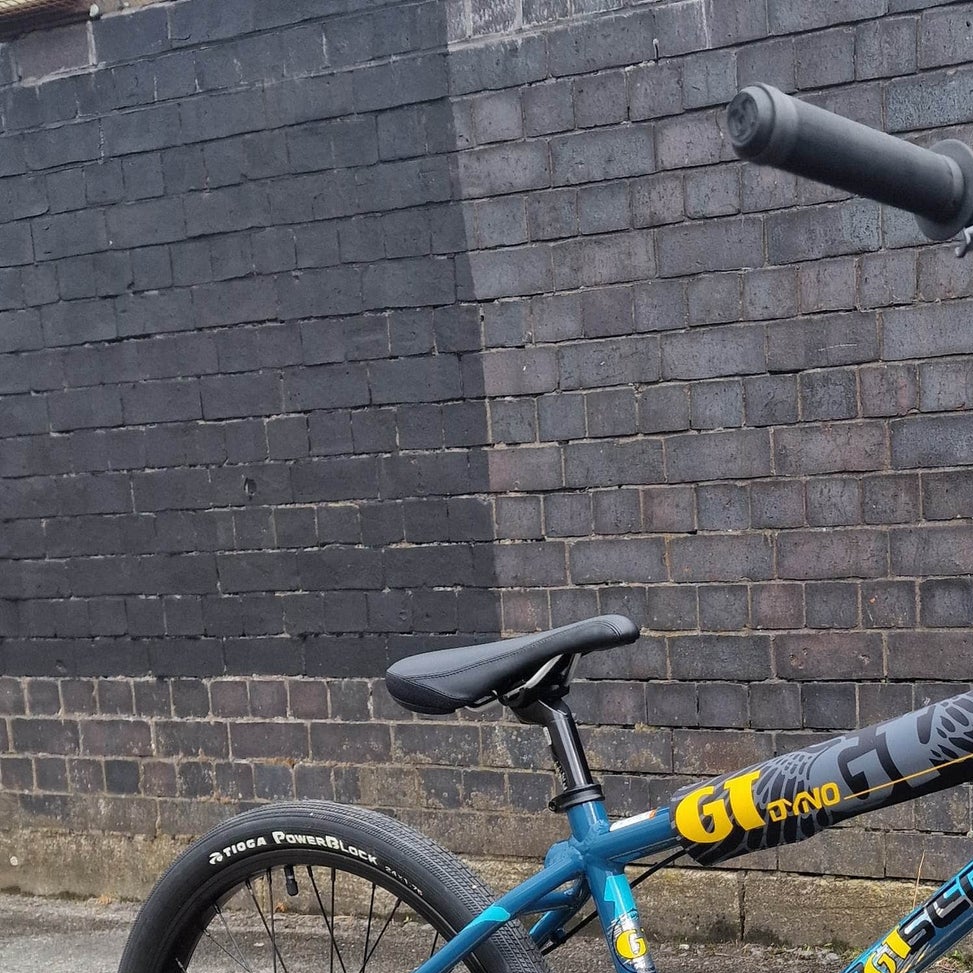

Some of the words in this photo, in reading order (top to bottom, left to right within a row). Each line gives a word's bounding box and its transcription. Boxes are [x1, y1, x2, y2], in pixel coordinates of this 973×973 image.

[675, 769, 766, 843] GT
[767, 781, 841, 822] DYNO
[223, 836, 267, 857] TIOGA
[615, 928, 647, 959] G
